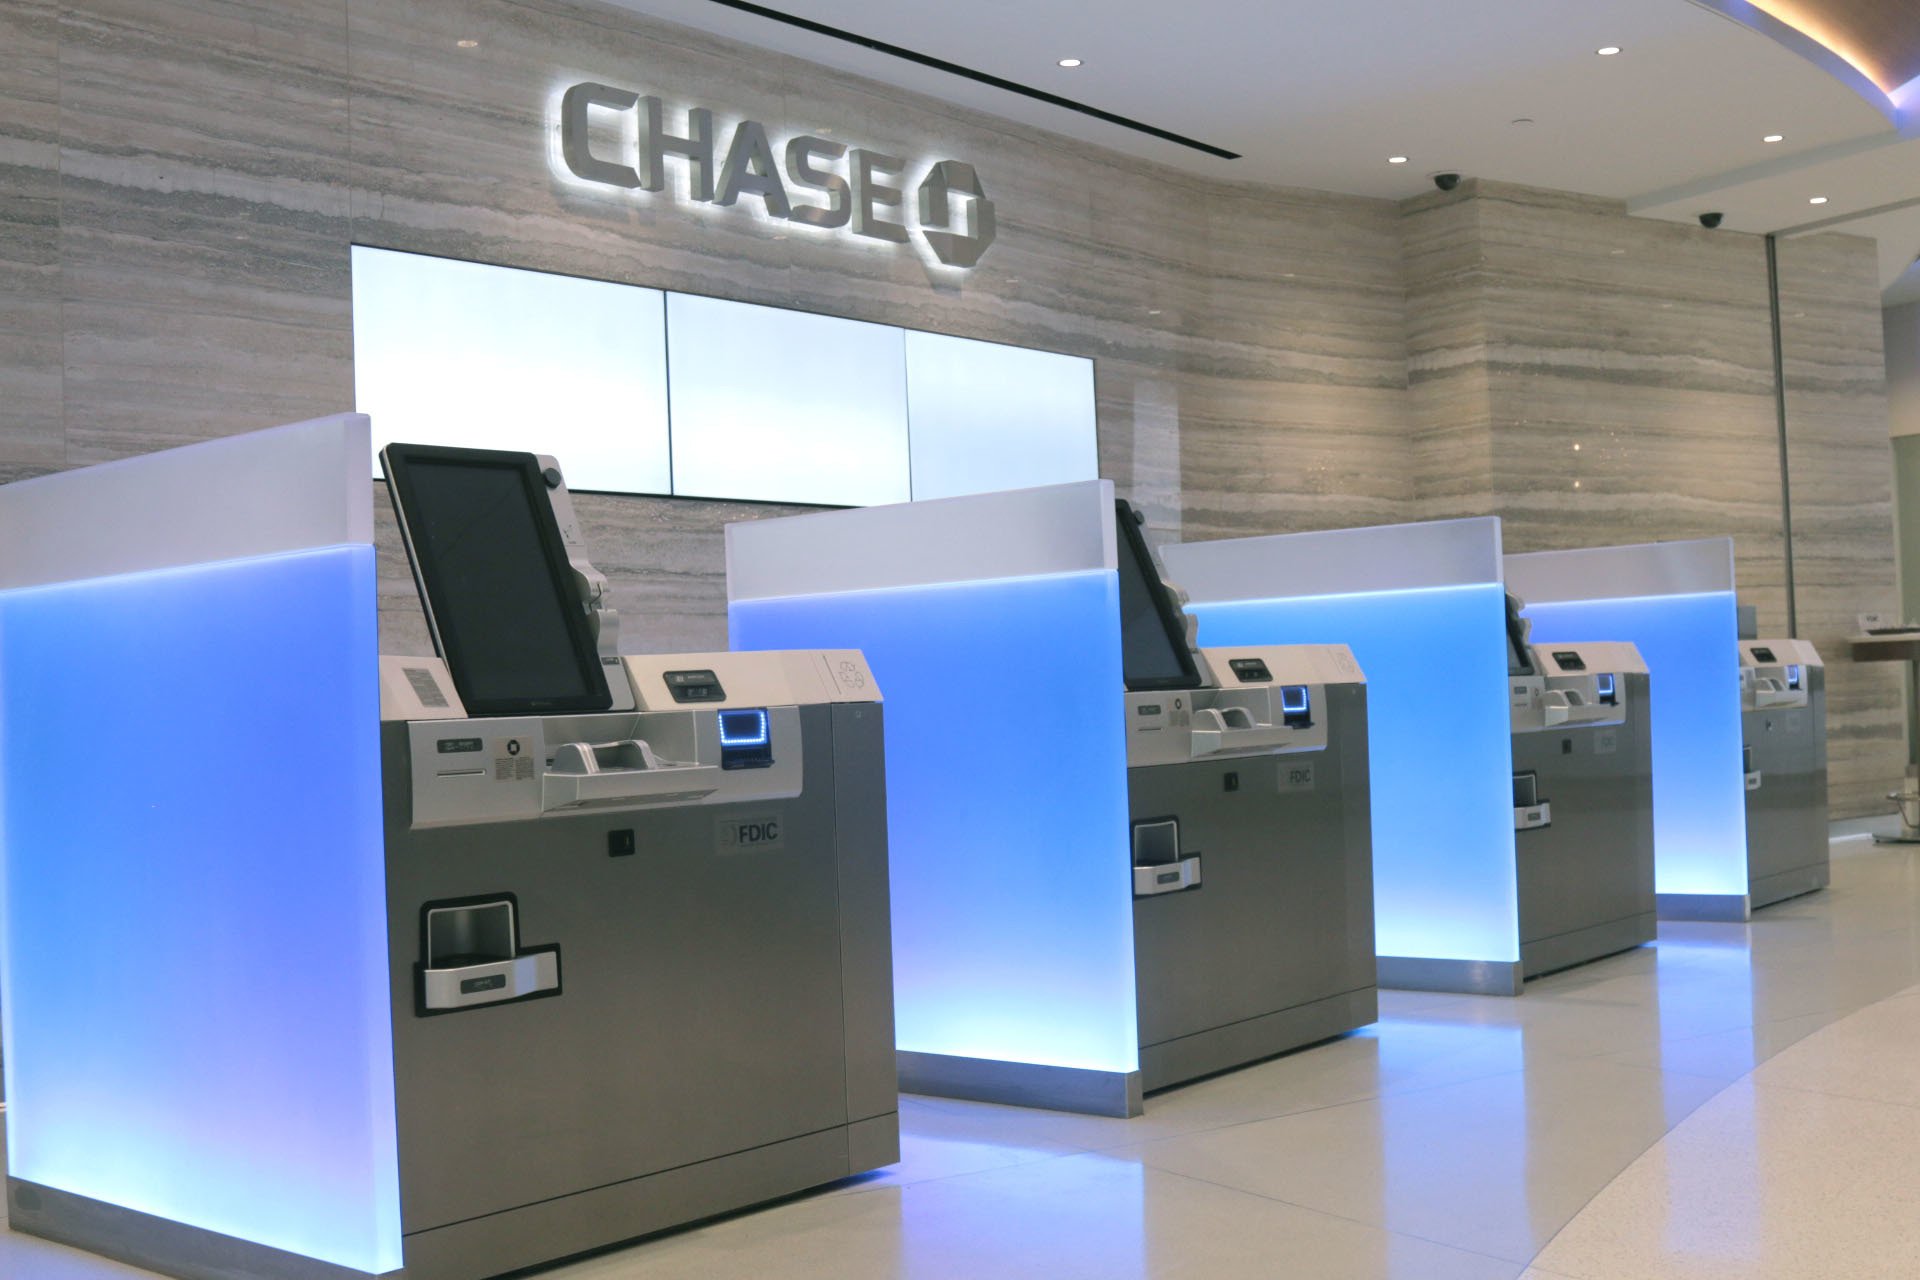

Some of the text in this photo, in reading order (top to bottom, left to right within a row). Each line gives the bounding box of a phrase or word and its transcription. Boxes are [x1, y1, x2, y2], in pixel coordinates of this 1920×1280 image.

[562, 82, 909, 243] CHASE
[1290, 769, 1311, 783] FDIC
[739, 822, 778, 843] FDIC
